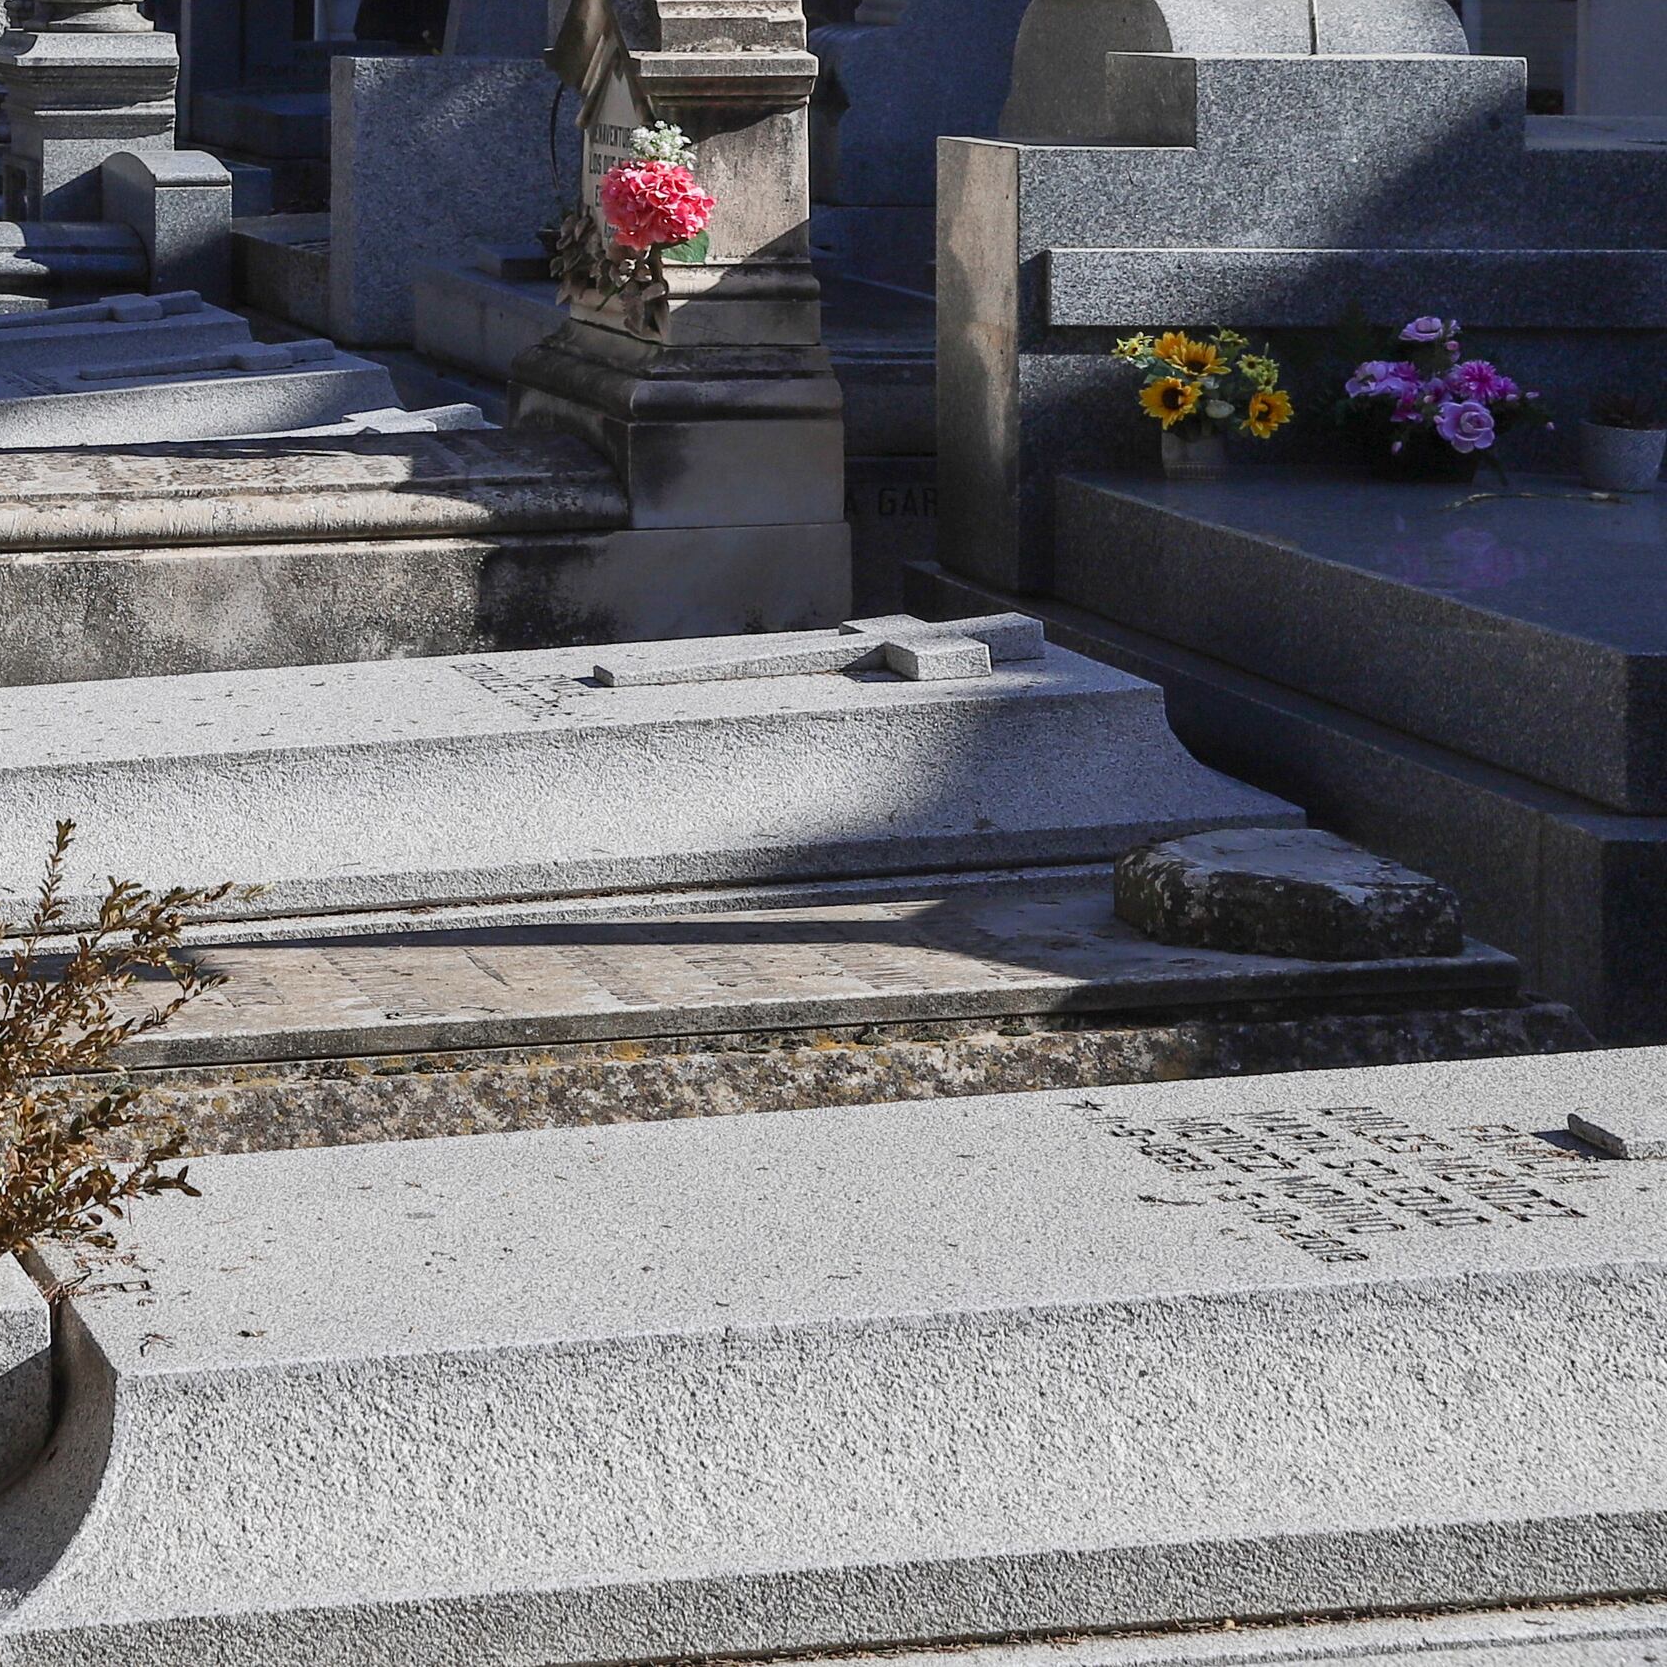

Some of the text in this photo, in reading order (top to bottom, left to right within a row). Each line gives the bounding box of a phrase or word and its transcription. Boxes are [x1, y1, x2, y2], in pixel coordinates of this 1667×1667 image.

[1156, 1116, 1303, 1173] MENDEZ
[1319, 1157, 1495, 1229] SOLEDAD
[1409, 1154, 1588, 1222] MENDEZ
